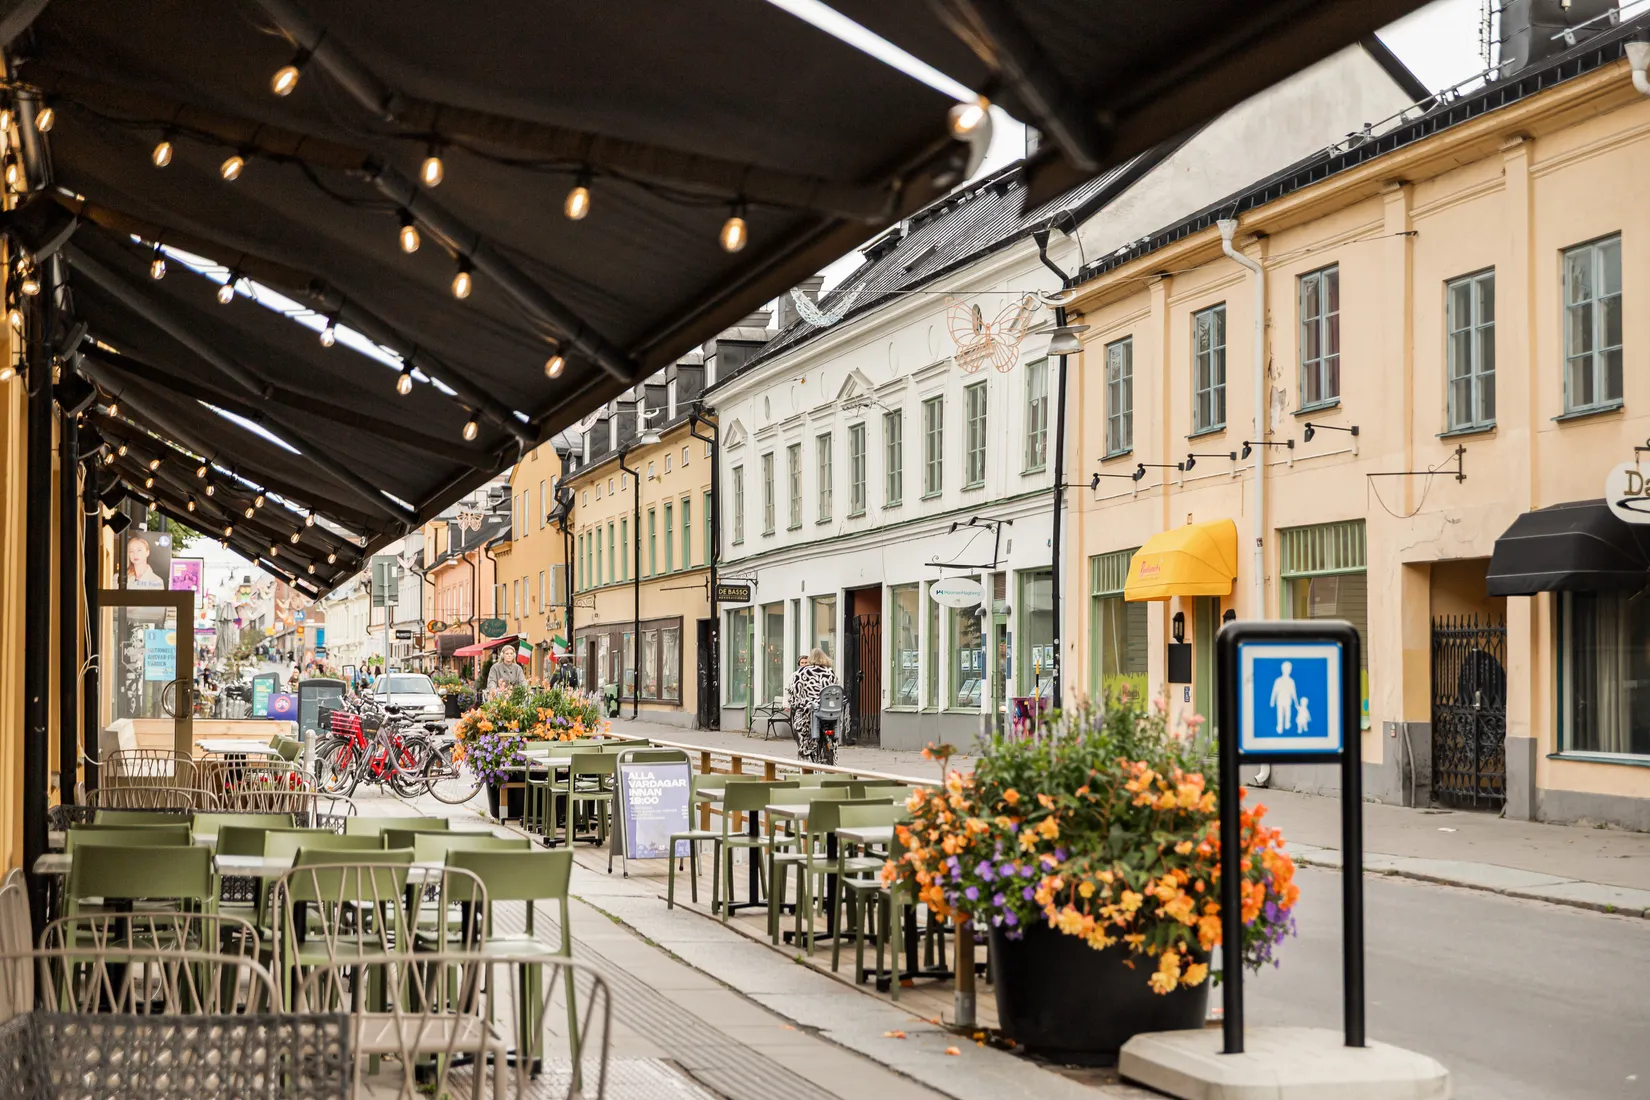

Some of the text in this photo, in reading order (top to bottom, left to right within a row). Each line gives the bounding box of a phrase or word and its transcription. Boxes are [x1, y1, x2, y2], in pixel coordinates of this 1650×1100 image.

[728, 588, 748, 596] BASSO
[628, 771, 655, 780] ALLA
[628, 779, 687, 788] VARDAGAR
[628, 788, 662, 797] INNAN
